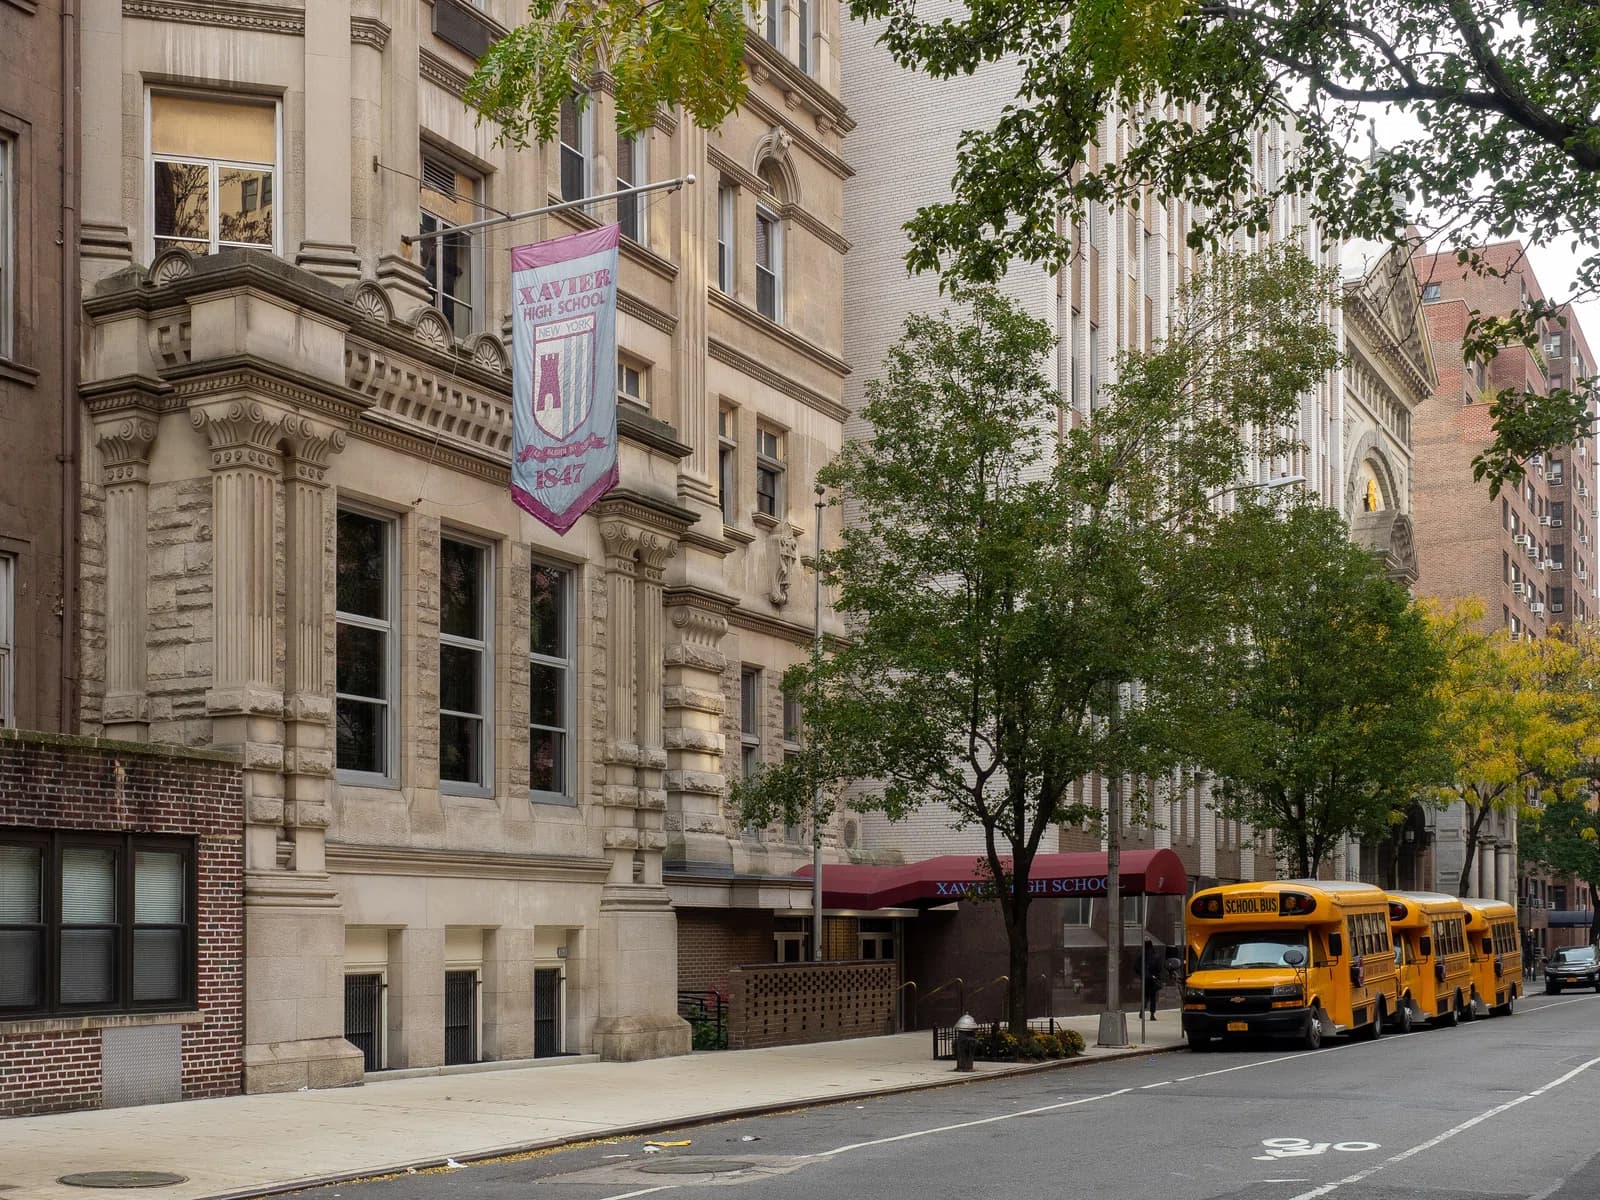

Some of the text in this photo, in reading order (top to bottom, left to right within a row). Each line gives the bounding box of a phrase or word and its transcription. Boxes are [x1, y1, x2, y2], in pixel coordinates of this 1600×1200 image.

[518, 268, 611, 305] XAVIER
[523, 291, 605, 321] HIGH SCHOOL
[538, 318, 593, 338] NEW YORK
[535, 463, 586, 490] 1847
[936, 882, 998, 895] XAV
[1226, 898, 1277, 913] SCHOOL BUS
